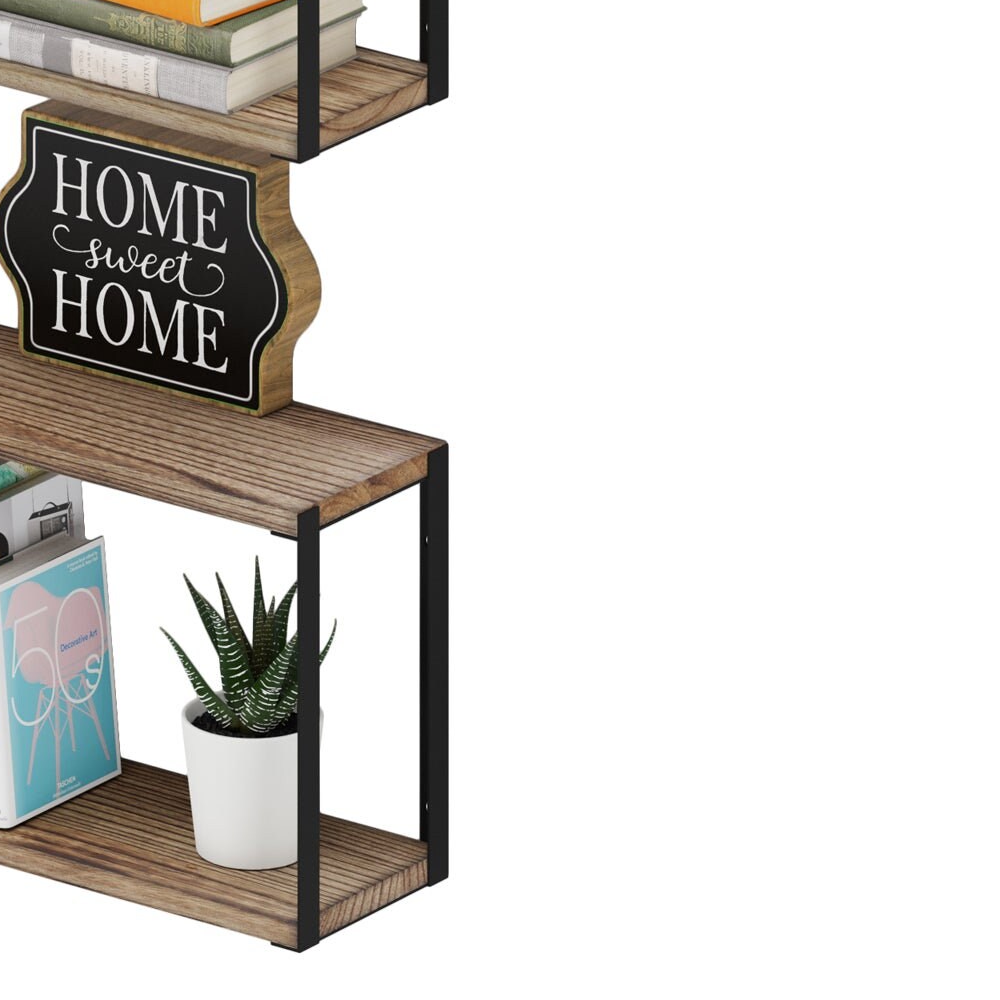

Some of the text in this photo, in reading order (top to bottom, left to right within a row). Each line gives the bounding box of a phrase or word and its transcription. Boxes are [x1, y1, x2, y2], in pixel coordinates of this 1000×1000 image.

[52, 152, 228, 254] HOME
[52, 224, 225, 297] sweet
[51, 268, 229, 374] HOME
[11, 587, 105, 727] 50s
[60, 628, 98, 653] Decorative Art
